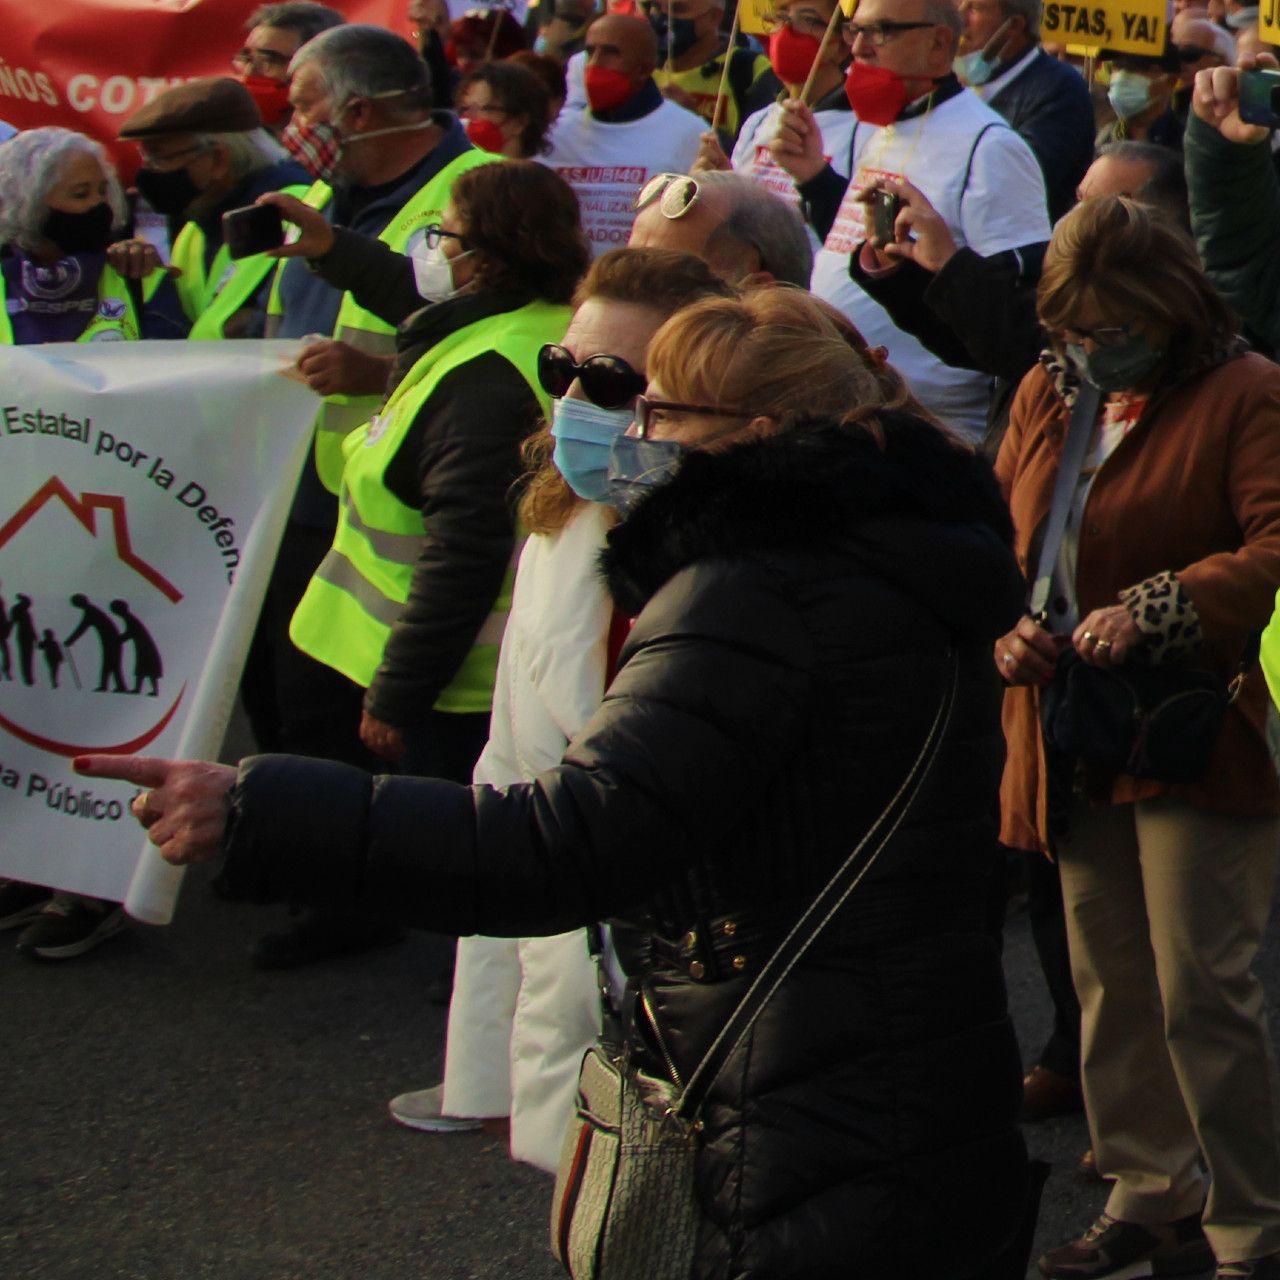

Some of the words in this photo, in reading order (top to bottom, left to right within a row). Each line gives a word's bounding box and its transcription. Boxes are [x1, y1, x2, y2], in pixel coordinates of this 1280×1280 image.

[1040, 2, 1113, 44] STAS,
[1121, 12, 1158, 44] YA!
[2, 406, 91, 444] Estatal
[94, 430, 149, 468] por
[147, 456, 177, 491] la
[26, 772, 123, 821] Público
